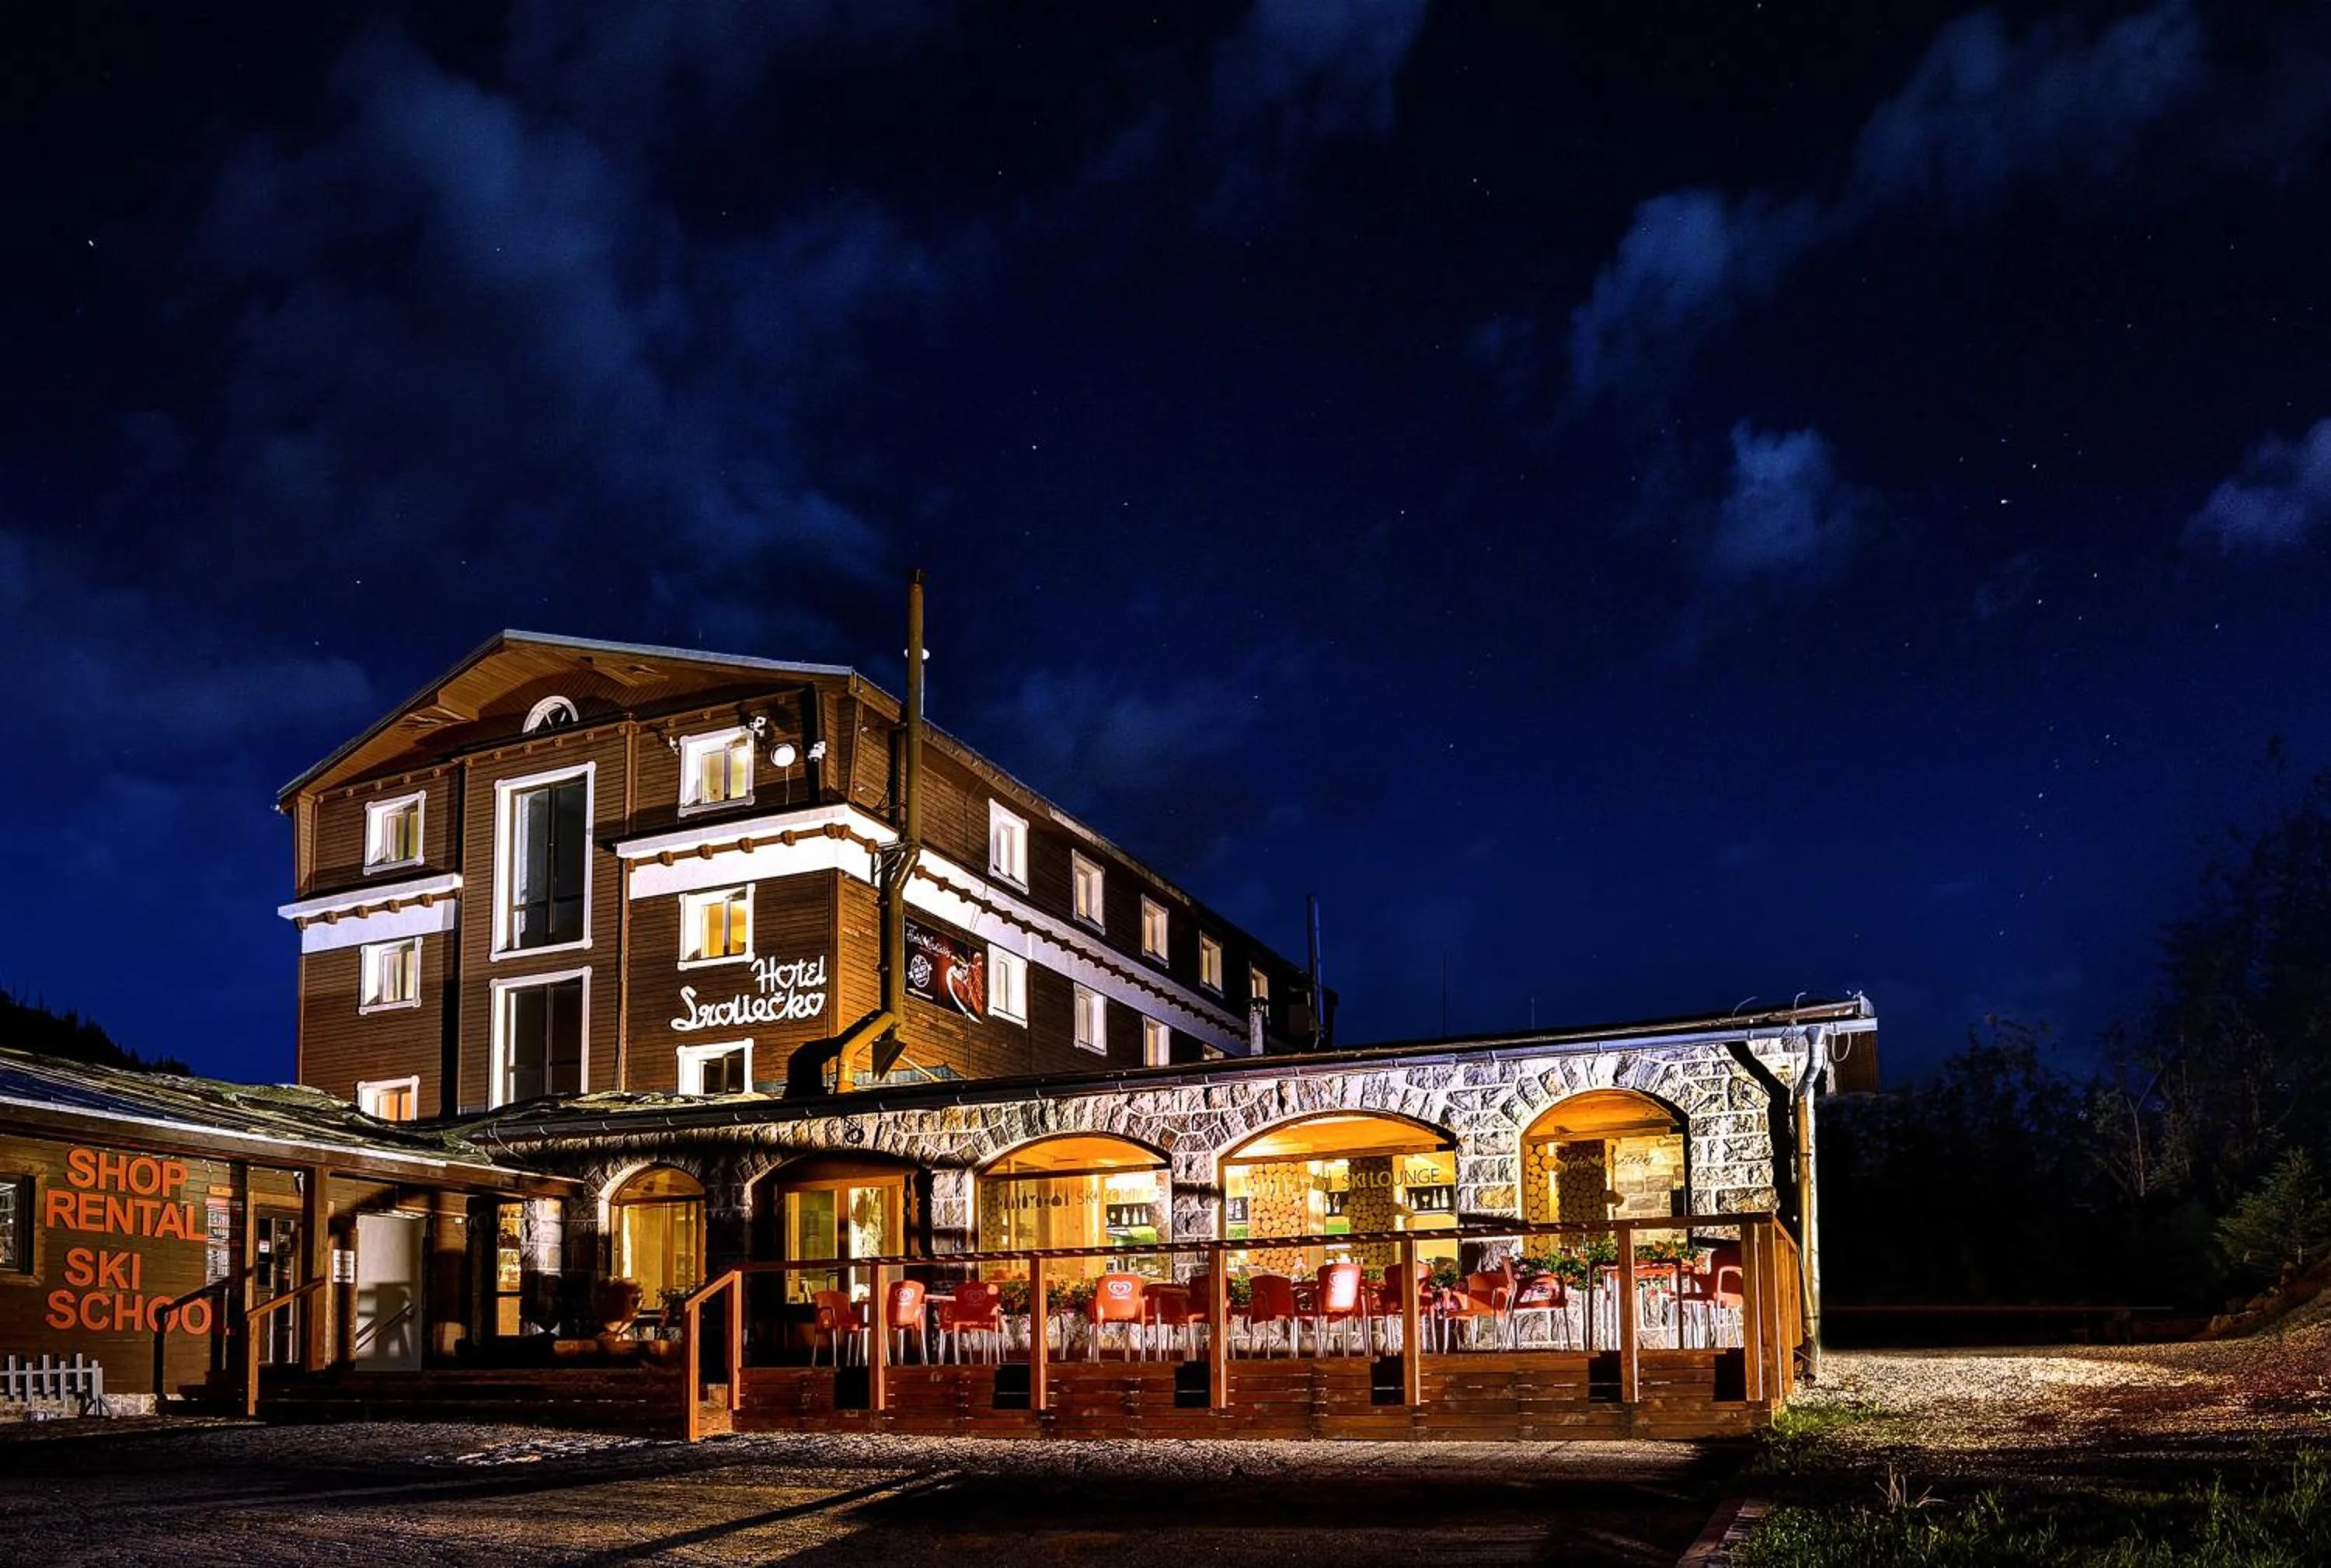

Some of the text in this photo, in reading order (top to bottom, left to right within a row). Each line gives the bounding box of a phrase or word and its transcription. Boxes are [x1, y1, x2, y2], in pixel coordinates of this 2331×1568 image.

[751, 956, 827, 994] Hotel
[67, 1148, 188, 1197] SHOP
[1343, 1168, 1440, 1190] SKI LOUNGE
[46, 1190, 208, 1242] RENTAL
[65, 1247, 141, 1290] SKI
